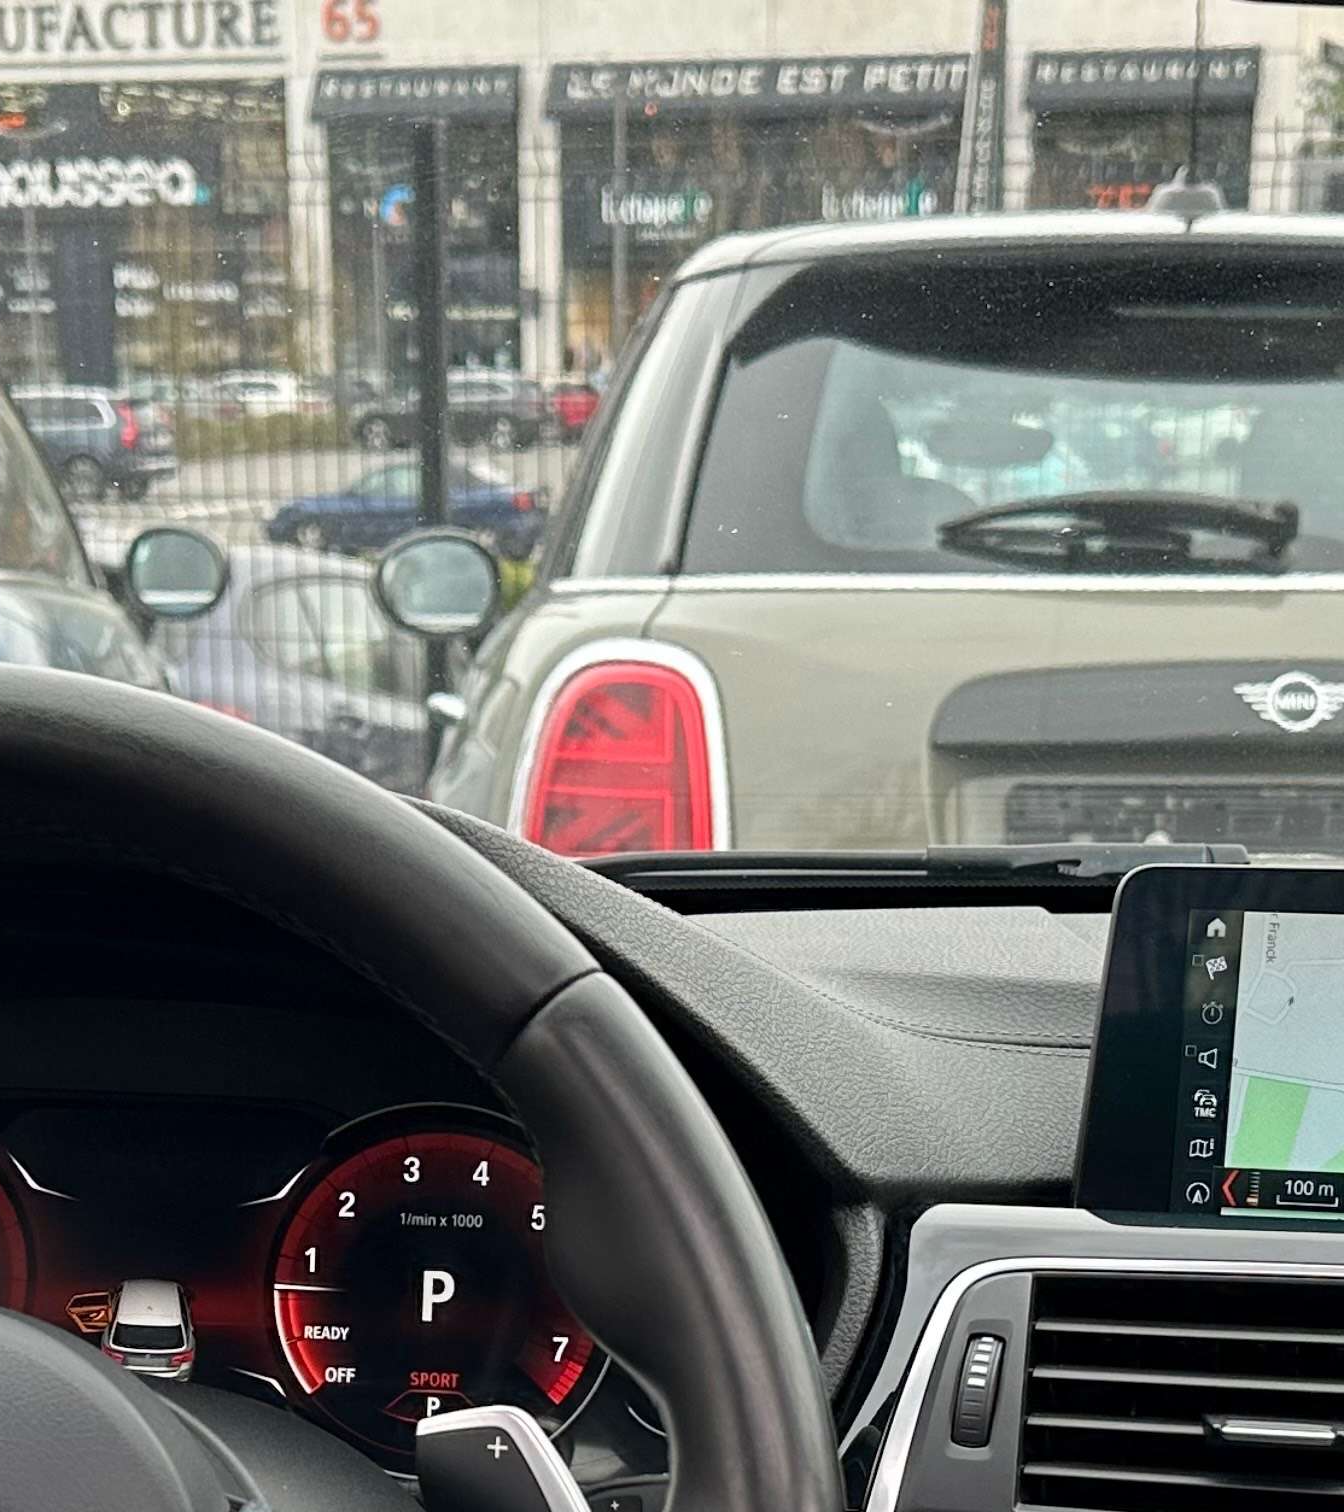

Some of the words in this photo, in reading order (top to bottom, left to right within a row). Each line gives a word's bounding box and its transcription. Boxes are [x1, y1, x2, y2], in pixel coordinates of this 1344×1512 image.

[320, 0, 381, 43] 65
[775, 64, 853, 95] EST
[864, 62, 968, 94] PETIT
[1265, 921, 1281, 964] Franck
[1194, 1107, 1216, 1118] TMC
[402, 1157, 420, 1183] 3
[472, 1161, 490, 1187] 4
[1284, 1179, 1314, 1196] 100
[1318, 1182, 1335, 1198] m
[338, 1192, 355, 1218] 2
[530, 1205, 546, 1231] 5
[399, 1211, 437, 1228] 1/min
[451, 1213, 484, 1229] 1000
[304, 1246, 317, 1274] 1
[421, 1269, 456, 1323] P
[303, 1324, 350, 1342] READY
[551, 1336, 569, 1363] 7
[324, 1367, 356, 1385] OFF
[409, 1371, 460, 1390] SPORT
[426, 1396, 441, 1417] P
